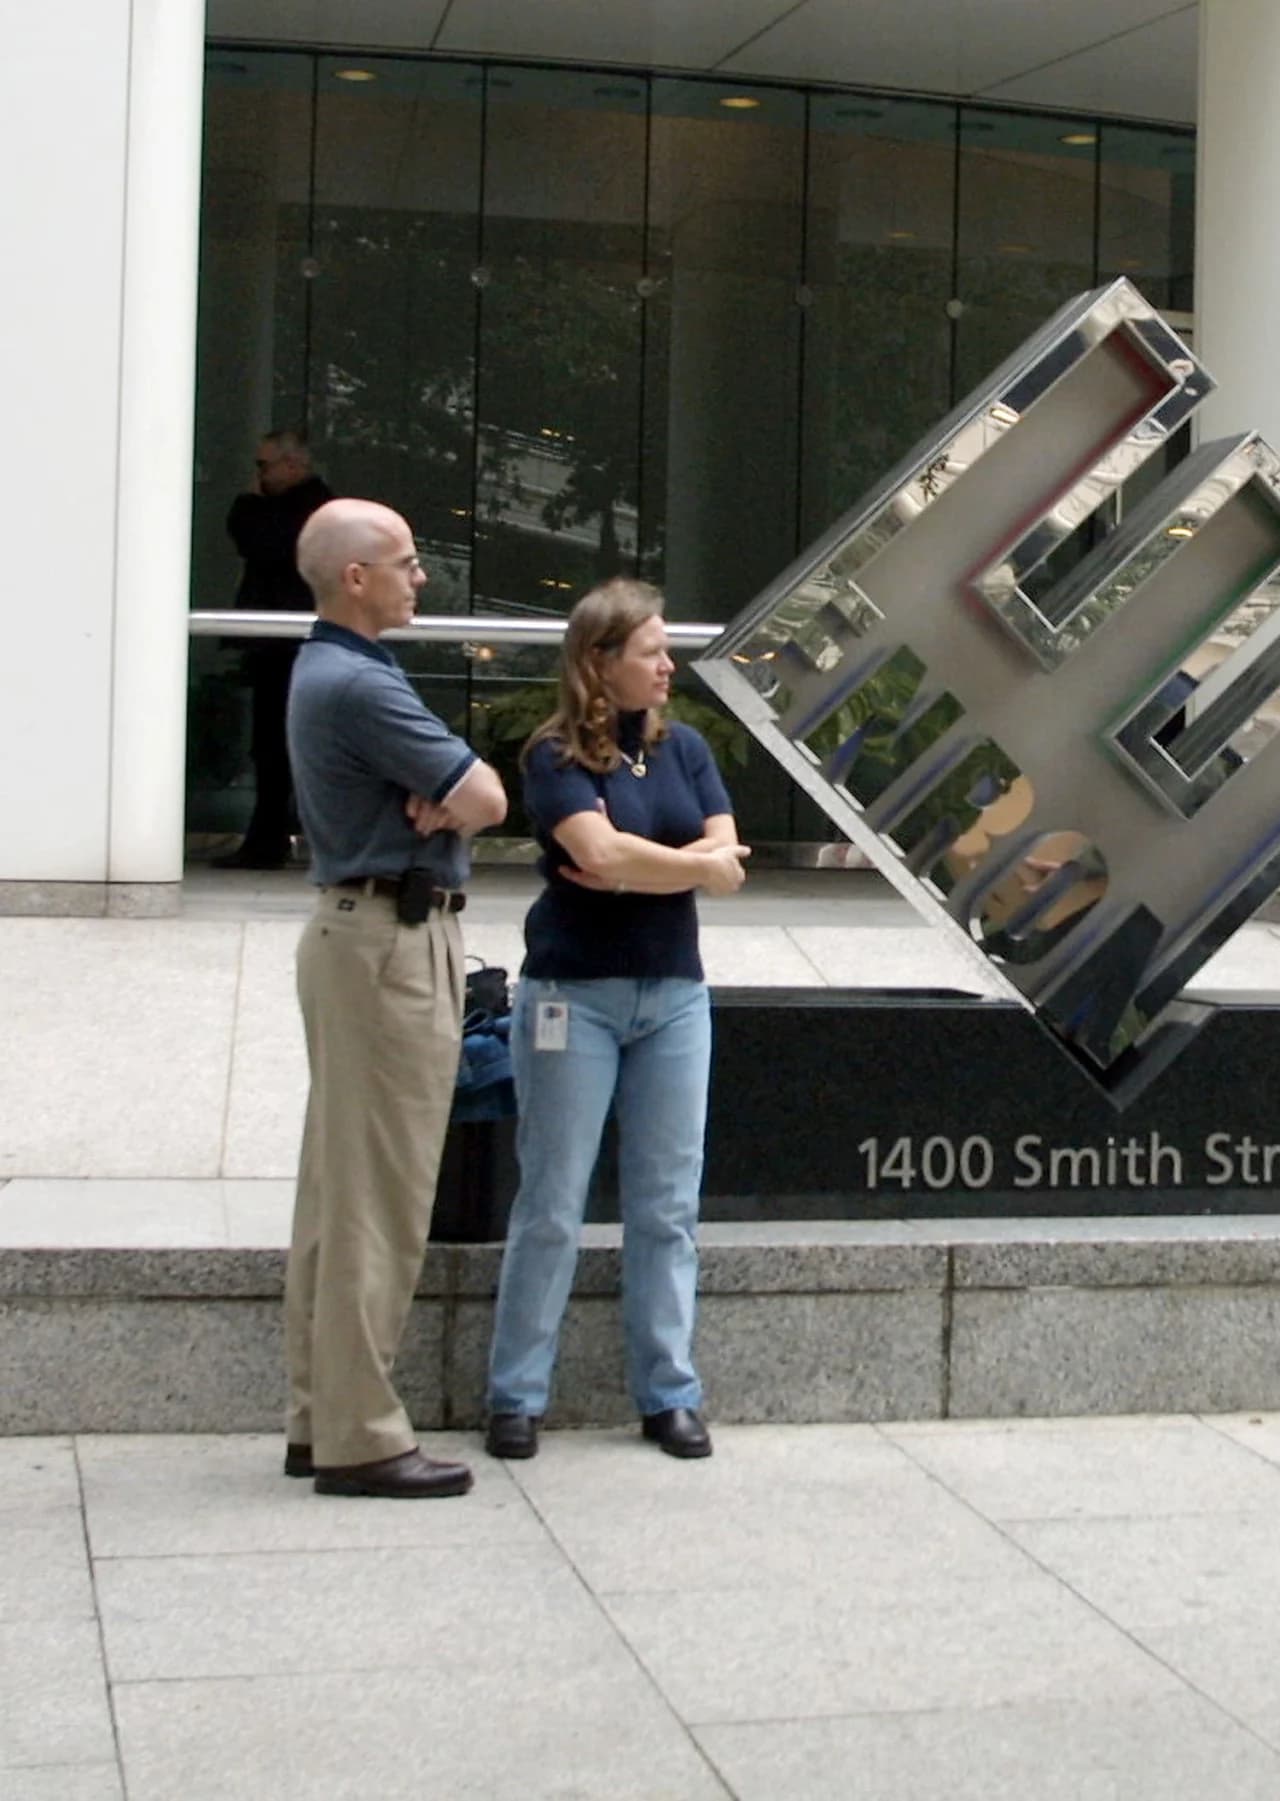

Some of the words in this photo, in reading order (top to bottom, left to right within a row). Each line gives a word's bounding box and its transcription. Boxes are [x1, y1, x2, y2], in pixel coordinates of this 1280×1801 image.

[722, 560, 1205, 1076] ENRON
[858, 1136, 995, 1188] 1400
[1013, 1131, 1183, 1186] Smith
